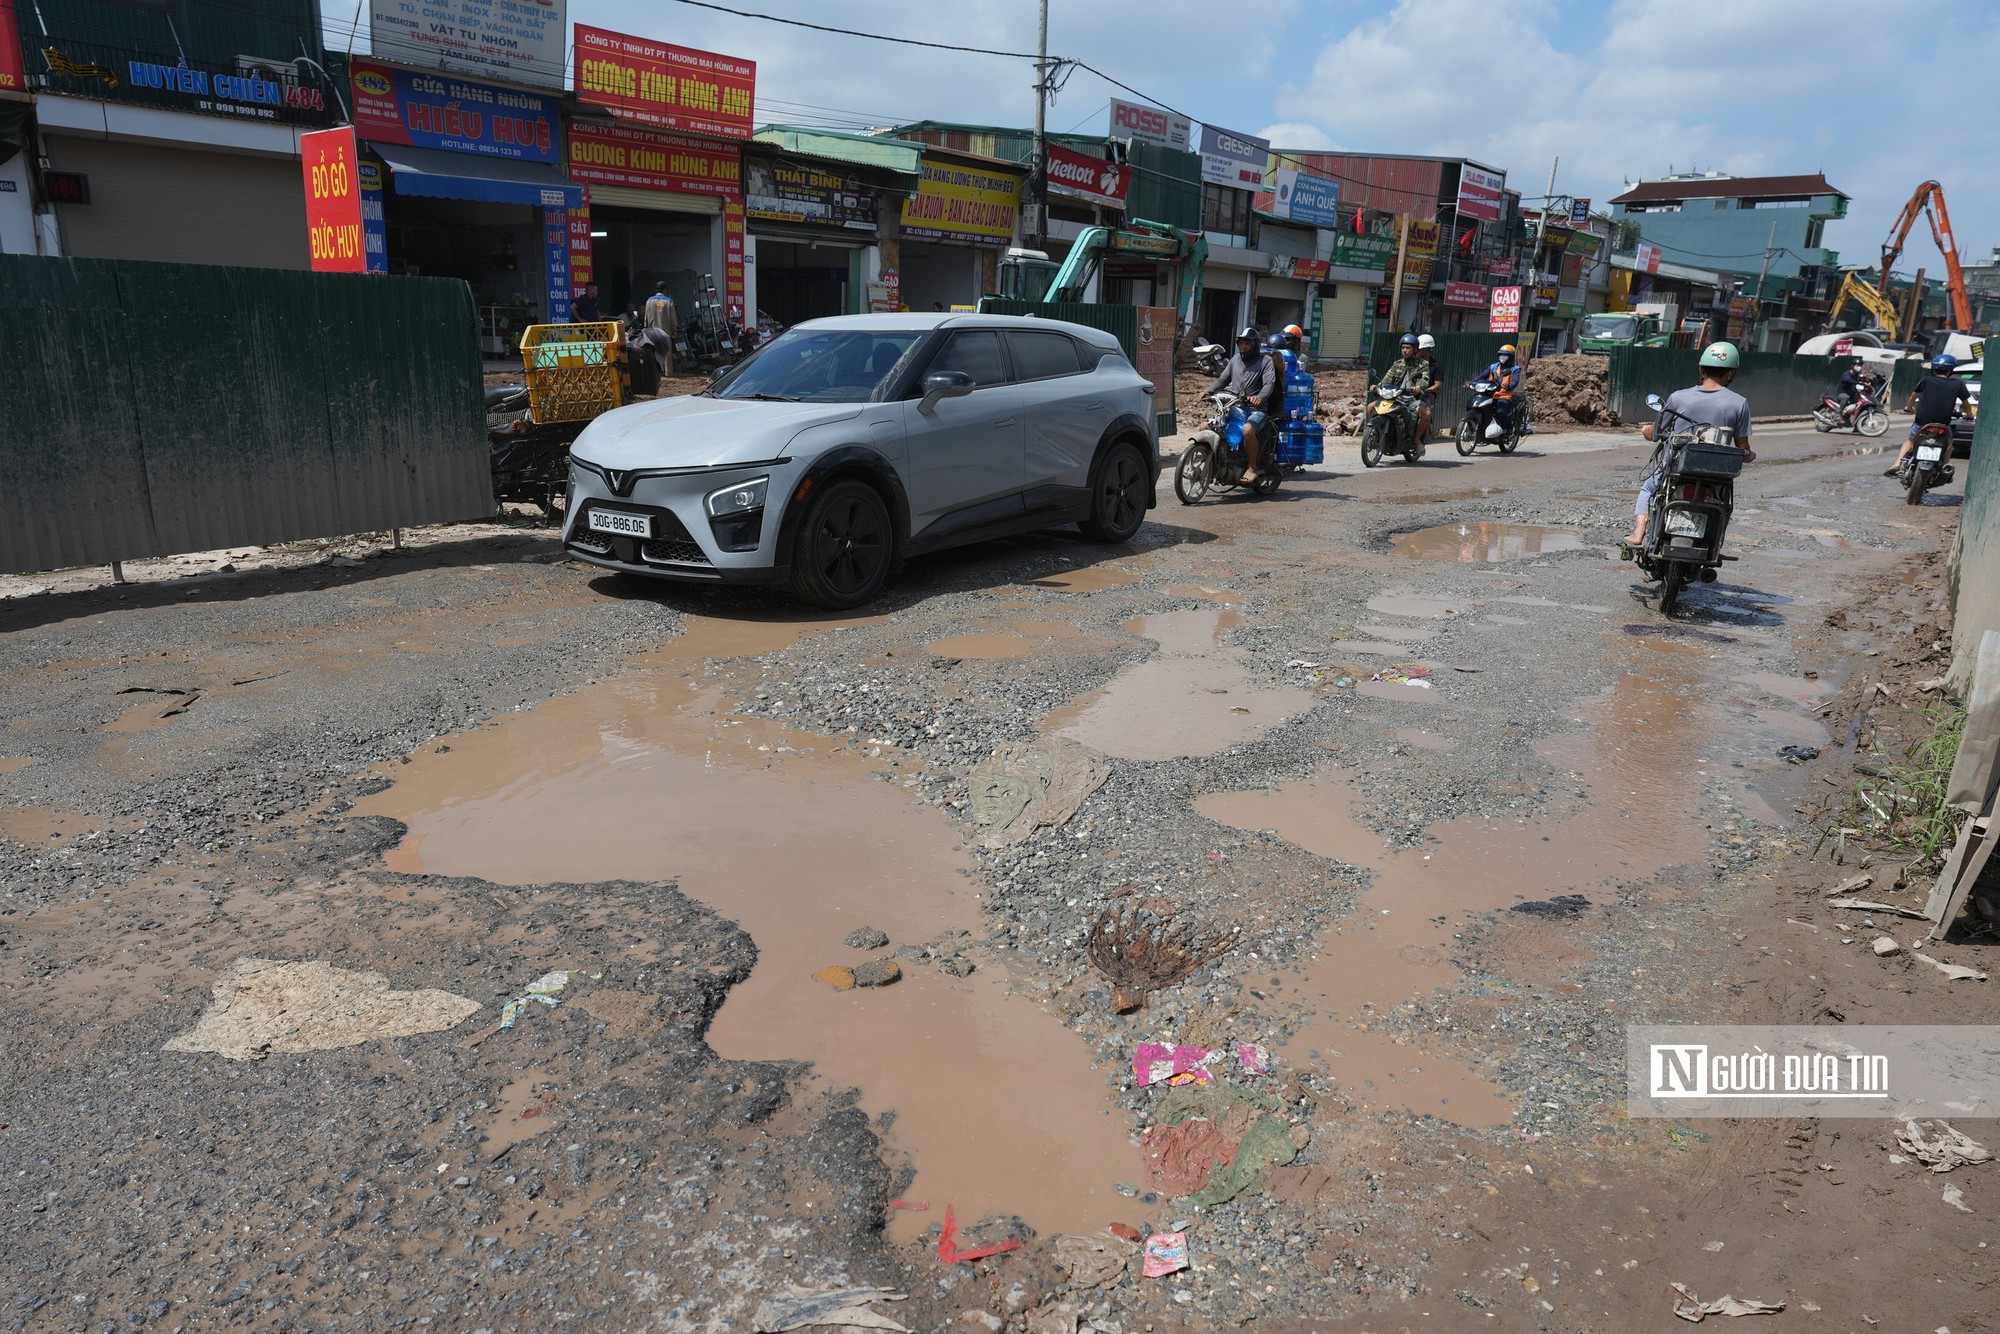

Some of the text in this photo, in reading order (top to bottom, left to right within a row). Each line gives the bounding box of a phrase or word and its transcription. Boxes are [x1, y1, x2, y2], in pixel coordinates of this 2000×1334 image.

[461, 4, 490, 18] INOX
[501, 13, 523, 25] HOA
[442, 36, 469, 51] SHIN
[481, 32, 518, 49] NHÔM
[490, 58, 510, 69] KIM
[584, 33, 608, 47] CÔNG
[609, 39, 620, 49] TY
[622, 42, 643, 54] TNHH
[656, 50, 666, 59] PT
[667, 51, 698, 66] THƯƠNG
[699, 58, 713, 71] MẠI
[735, 66, 750, 76] ANH
[128, 56, 209, 96] HUYỀN
[286, 85, 325, 112] 484
[359, 74, 388, 94] 482
[412, 74, 542, 112] CỬA HÀNG NHÔM
[582, 58, 750, 118] GƯƠNG KÍNH HÙNG ANH
[200, 100, 274, 118] ĐT 098 1996 892
[407, 100, 551, 155] HIẾU HUỆ
[1115, 103, 1168, 136] ROSSI
[441, 139, 478, 151] HOTLINE:
[500, 147, 512, 156] 123
[598, 126, 610, 135] TY
[611, 128, 632, 139] TNHH
[645, 133, 655, 141] PT
[723, 144, 738, 153] ANH
[571, 141, 739, 181] GƯƠNG KÍNH HÙNG ANH
[311, 146, 348, 199] ĐỒ GỖ
[774, 168, 842, 190] THÁI BÌNH
[1047, 156, 1096, 185] Vietlott
[1294, 191, 1315, 207] ANH
[726, 218, 743, 233] KÍNH
[311, 217, 360, 260] ĐỨC HUY
[572, 237, 589, 250] MÀI
[570, 255, 591, 266] GƯƠNG
[574, 270, 589, 282] KÍNH
[728, 266, 742, 277] CÔNG
[553, 277, 564, 286] THI
[884, 275, 899, 289] GẠO
[550, 289, 569, 300] CÔNG
[728, 295, 735, 304] UY
[1494, 288, 1519, 307] GẠO
[554, 303, 566, 315] TẠI
[1154, 322, 1175, 340] Coffee
[593, 513, 645, 534] 30G-886.06
